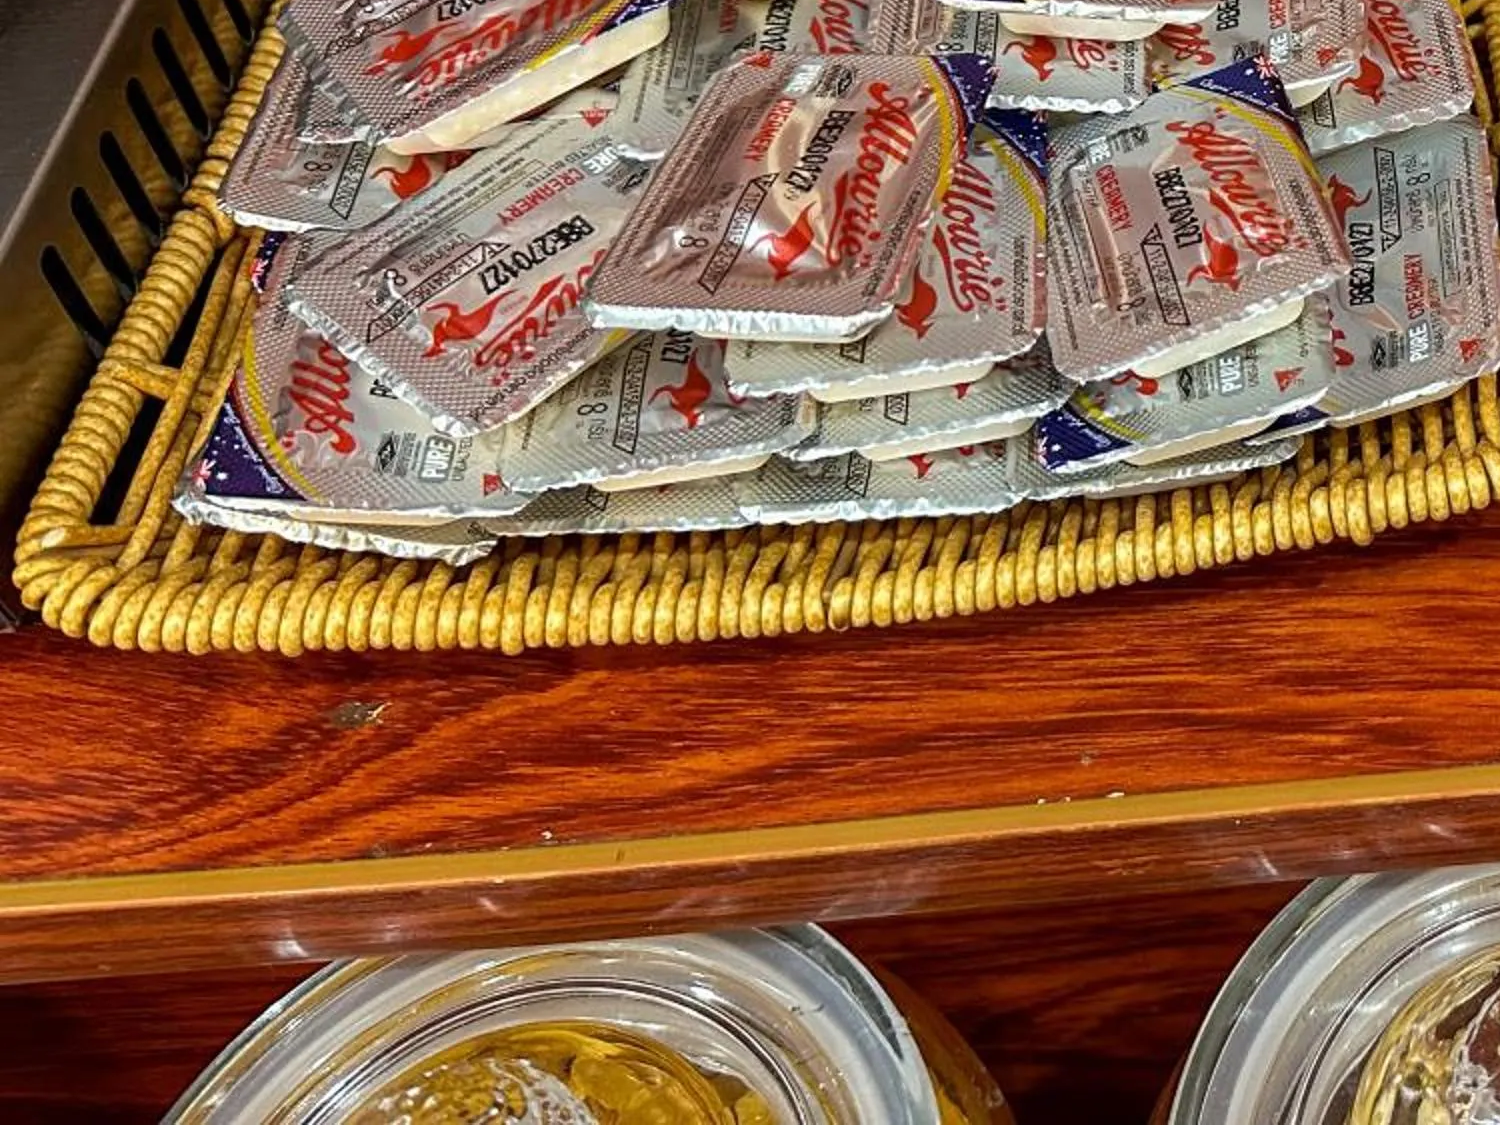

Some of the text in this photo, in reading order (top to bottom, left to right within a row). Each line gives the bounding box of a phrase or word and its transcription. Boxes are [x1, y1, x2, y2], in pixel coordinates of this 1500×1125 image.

[743, 98, 797, 162] CREAMERY
[500, 168, 584, 225] CREAMERY
[1096, 165, 1134, 233] CREAMERY
[1153, 167, 1202, 248] BBE270127
[1405, 171, 1431, 187] 8
[479, 215, 596, 294] BBE270127
[1350, 222, 1375, 306] BBE270127
[1404, 253, 1428, 363] PURE CREAMERY
[1220, 354, 1241, 394] PURE
[577, 401, 608, 418] 8
[421, 437, 454, 482] PURE
